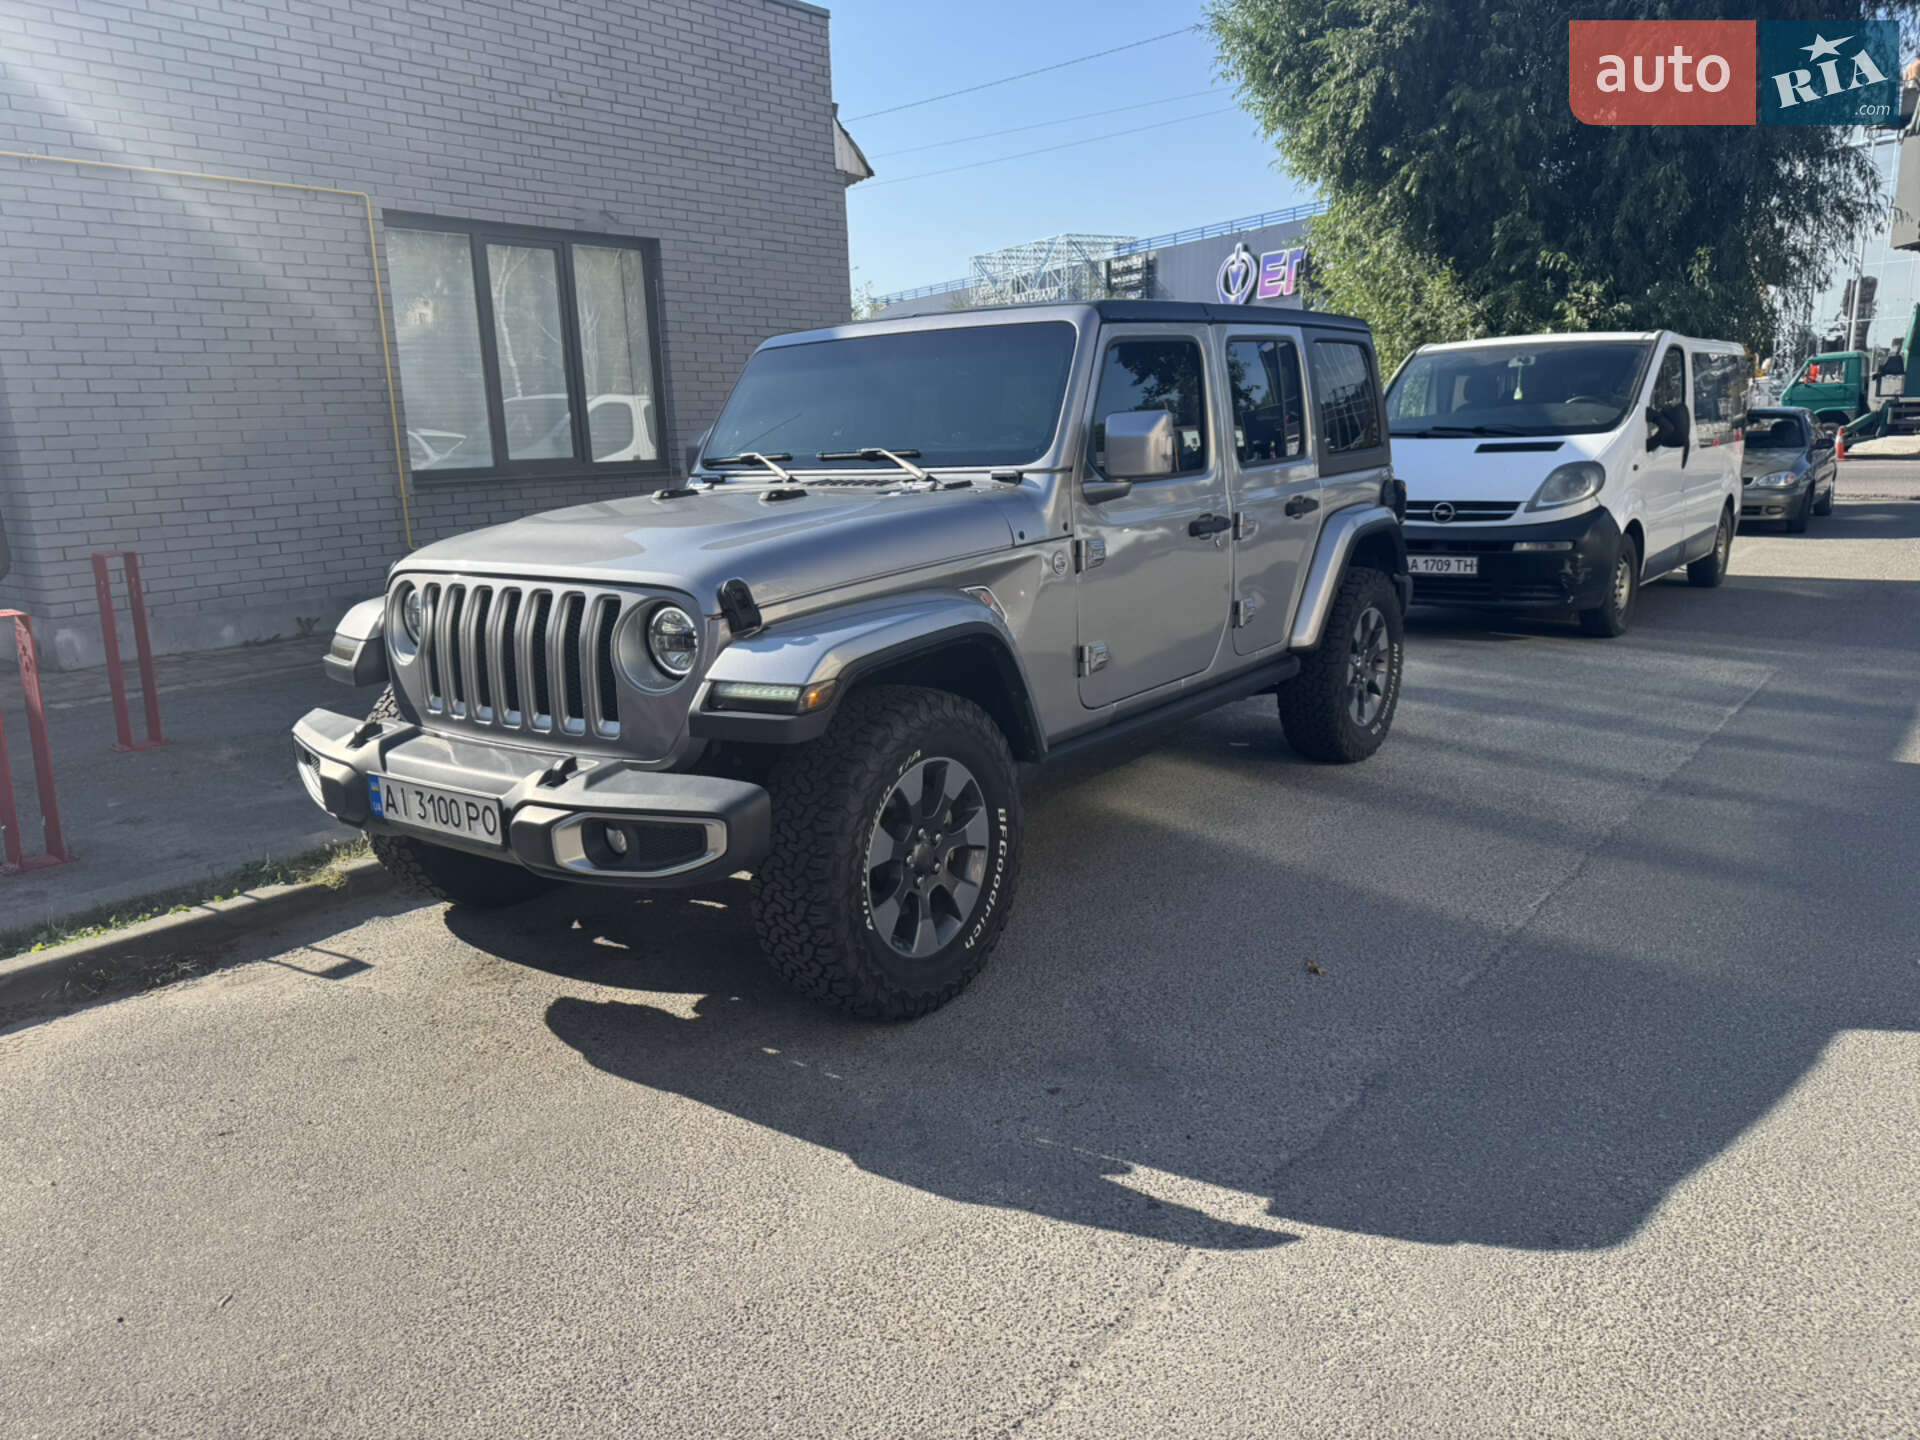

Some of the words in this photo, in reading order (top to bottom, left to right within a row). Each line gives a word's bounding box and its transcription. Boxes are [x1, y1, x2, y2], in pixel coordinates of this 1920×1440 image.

[1423, 559, 1451, 572] 1709
[1454, 559, 1474, 572] TH
[385, 784, 407, 816] AI
[414, 790, 461, 828] 3100
[464, 801, 497, 836] PO
